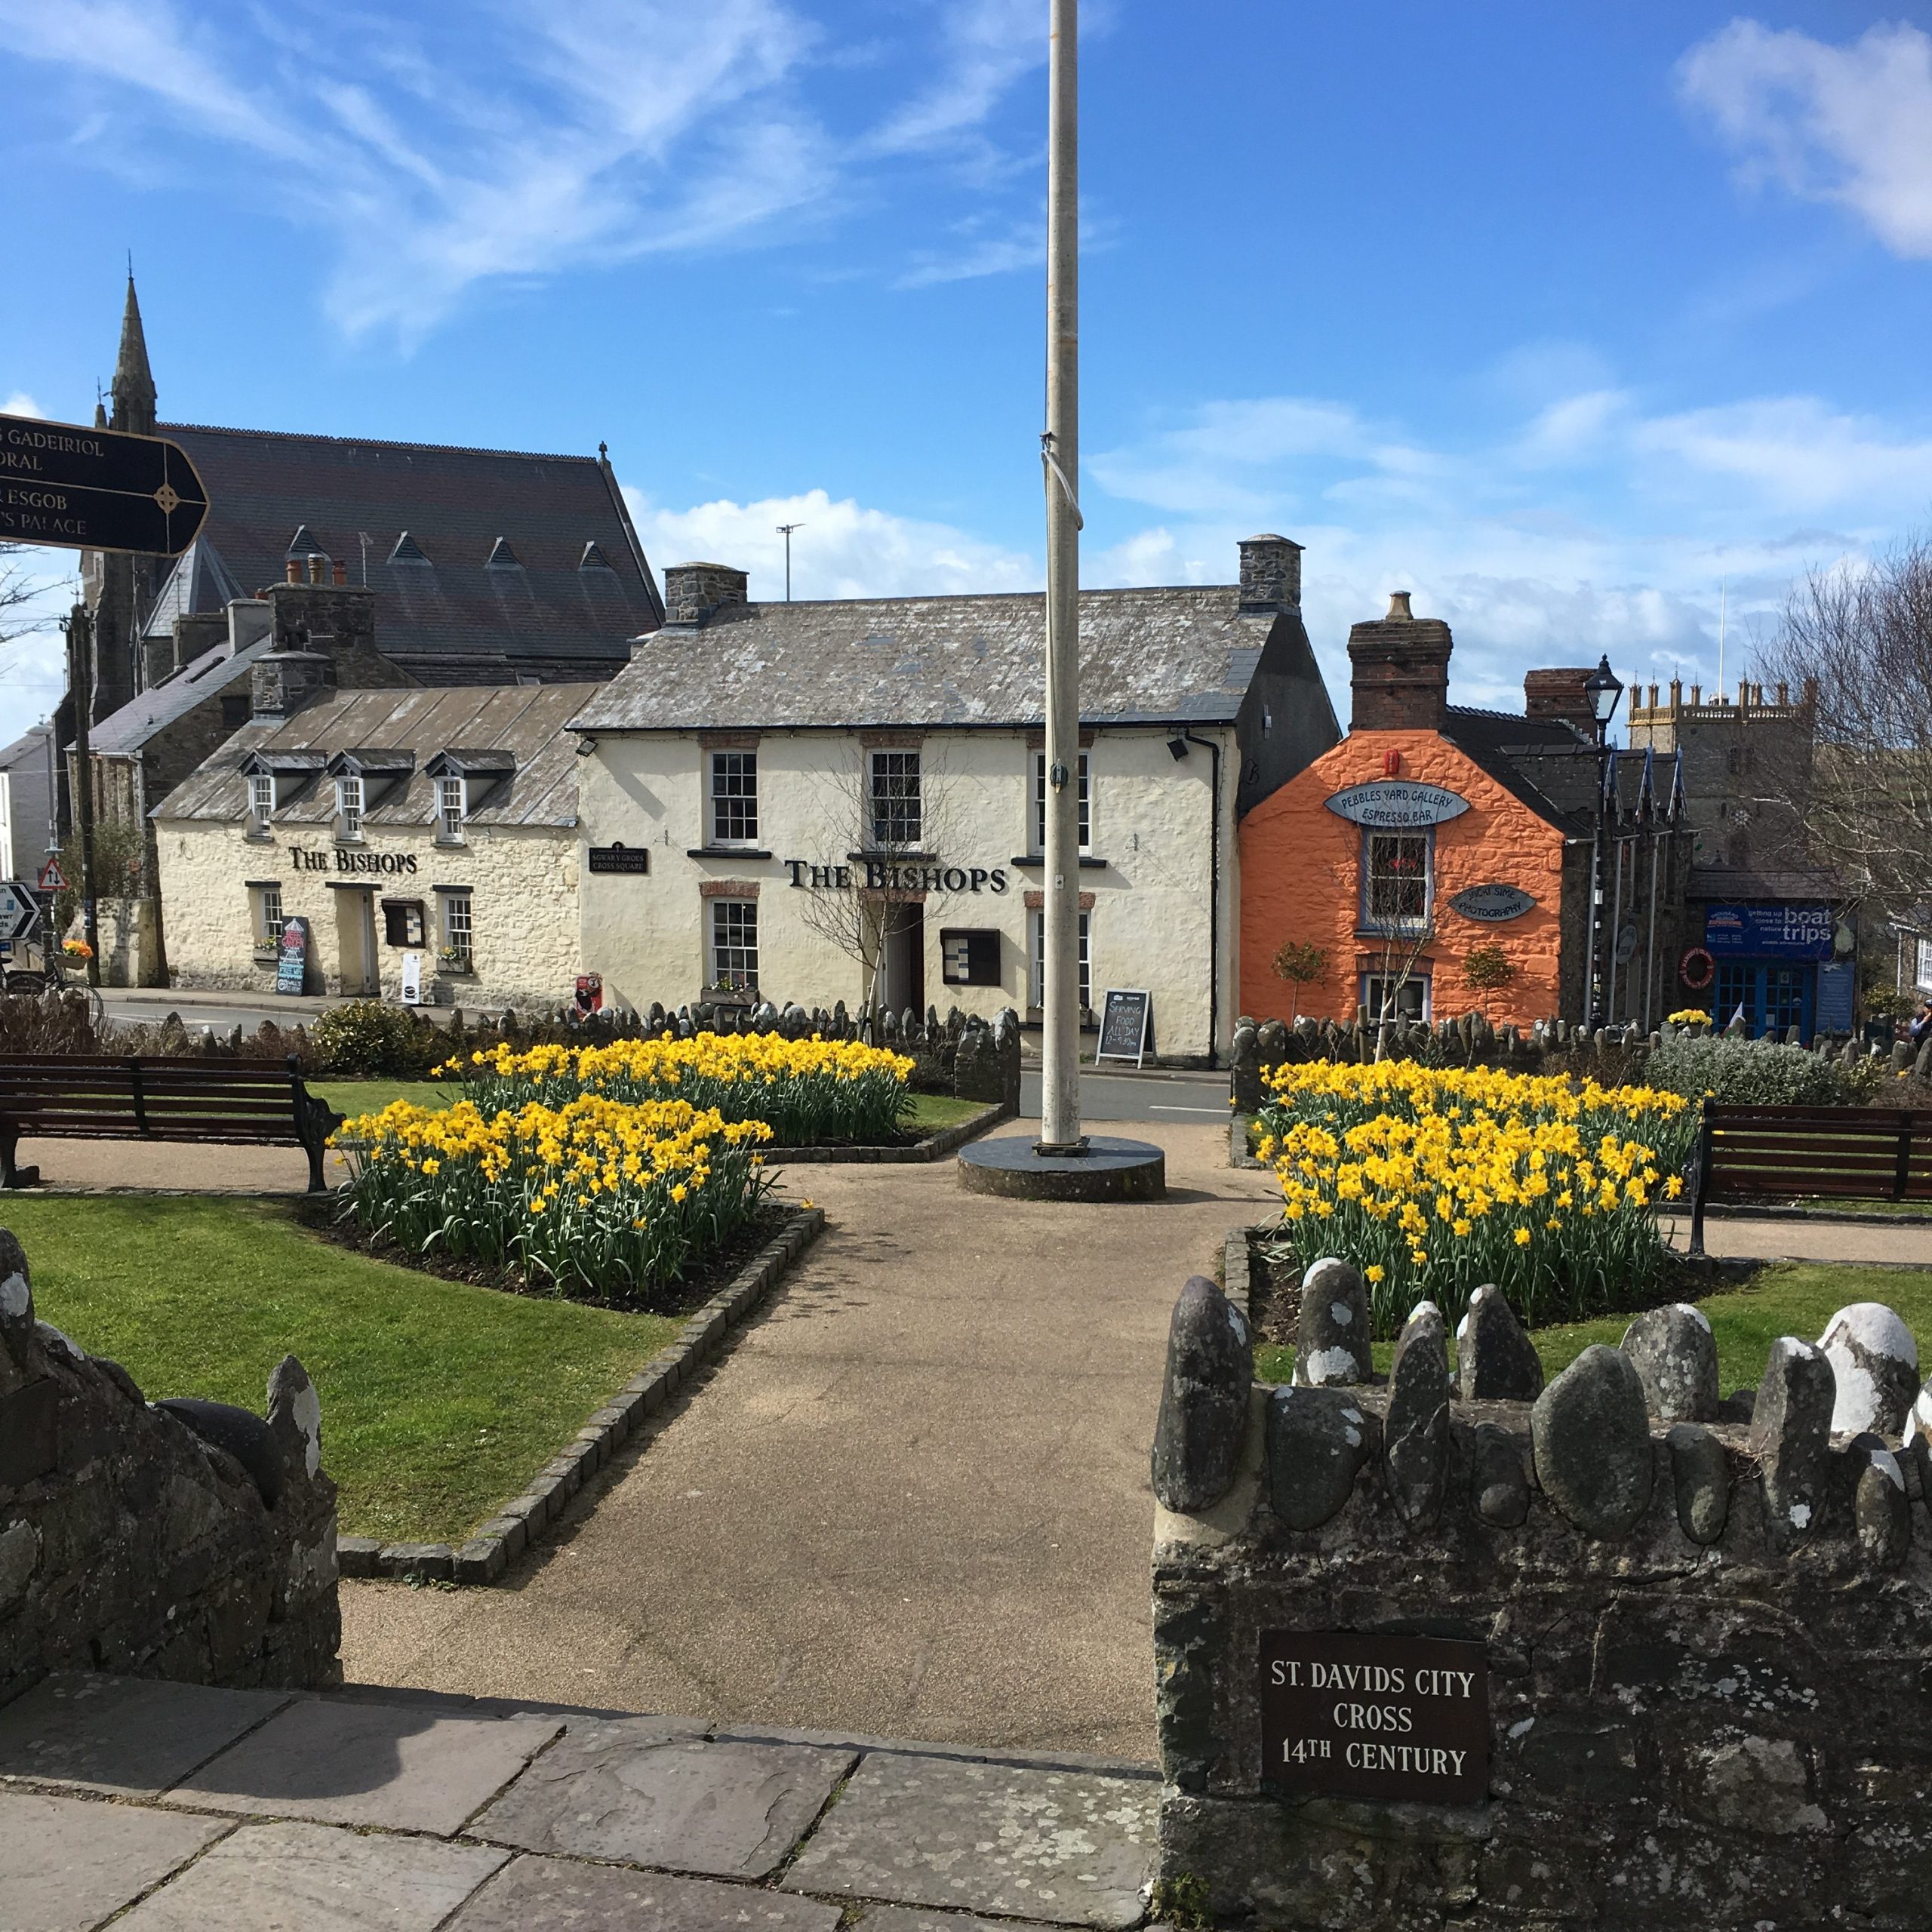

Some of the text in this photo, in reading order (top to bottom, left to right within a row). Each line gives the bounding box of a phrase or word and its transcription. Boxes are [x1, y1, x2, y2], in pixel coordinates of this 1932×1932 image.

[8, 429, 104, 457] GADEIRIOL
[8, 489, 66, 510] ESGOB
[1341, 789, 1453, 810] PEBBLES YARD GALLERY
[1361, 808, 1432, 823] ESPRESSO BAR
[289, 846, 417, 874] THE BISHOPS
[615, 863, 644, 871] SQUARE
[785, 860, 1006, 893] THE BISHOPS
[1459, 902, 1522, 918] PHOTOGRAPHY
[1784, 906, 1832, 924] boat
[1783, 924, 1832, 944] trips
[1109, 1001, 1141, 1014] SERVING
[1107, 1025, 1140, 1036] ALL DAY
[1116, 1016, 1135, 1026] FOOD
[1271, 1660, 1475, 1698] ST. DAVIDS CITY
[1334, 1703, 1413, 1733] CROSS
[1282, 1737, 1467, 1777] 14TH CENTURY
